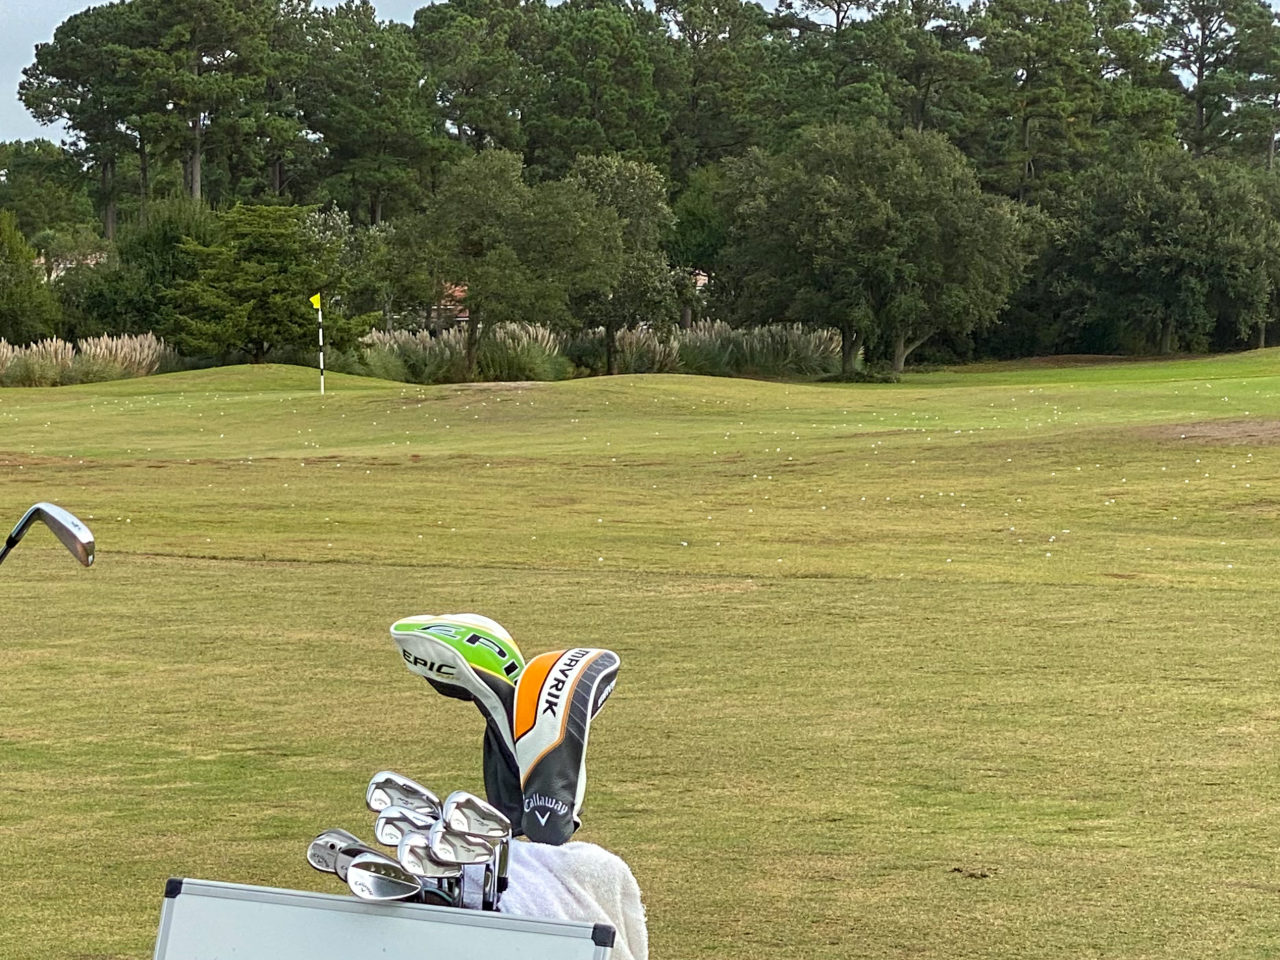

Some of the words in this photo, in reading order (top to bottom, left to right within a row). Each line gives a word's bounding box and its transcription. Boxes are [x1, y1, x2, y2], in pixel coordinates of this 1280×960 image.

[402, 648, 457, 676] EPIC
[542, 649, 591, 718] MAVRIK
[523, 792, 569, 815] Callaway
